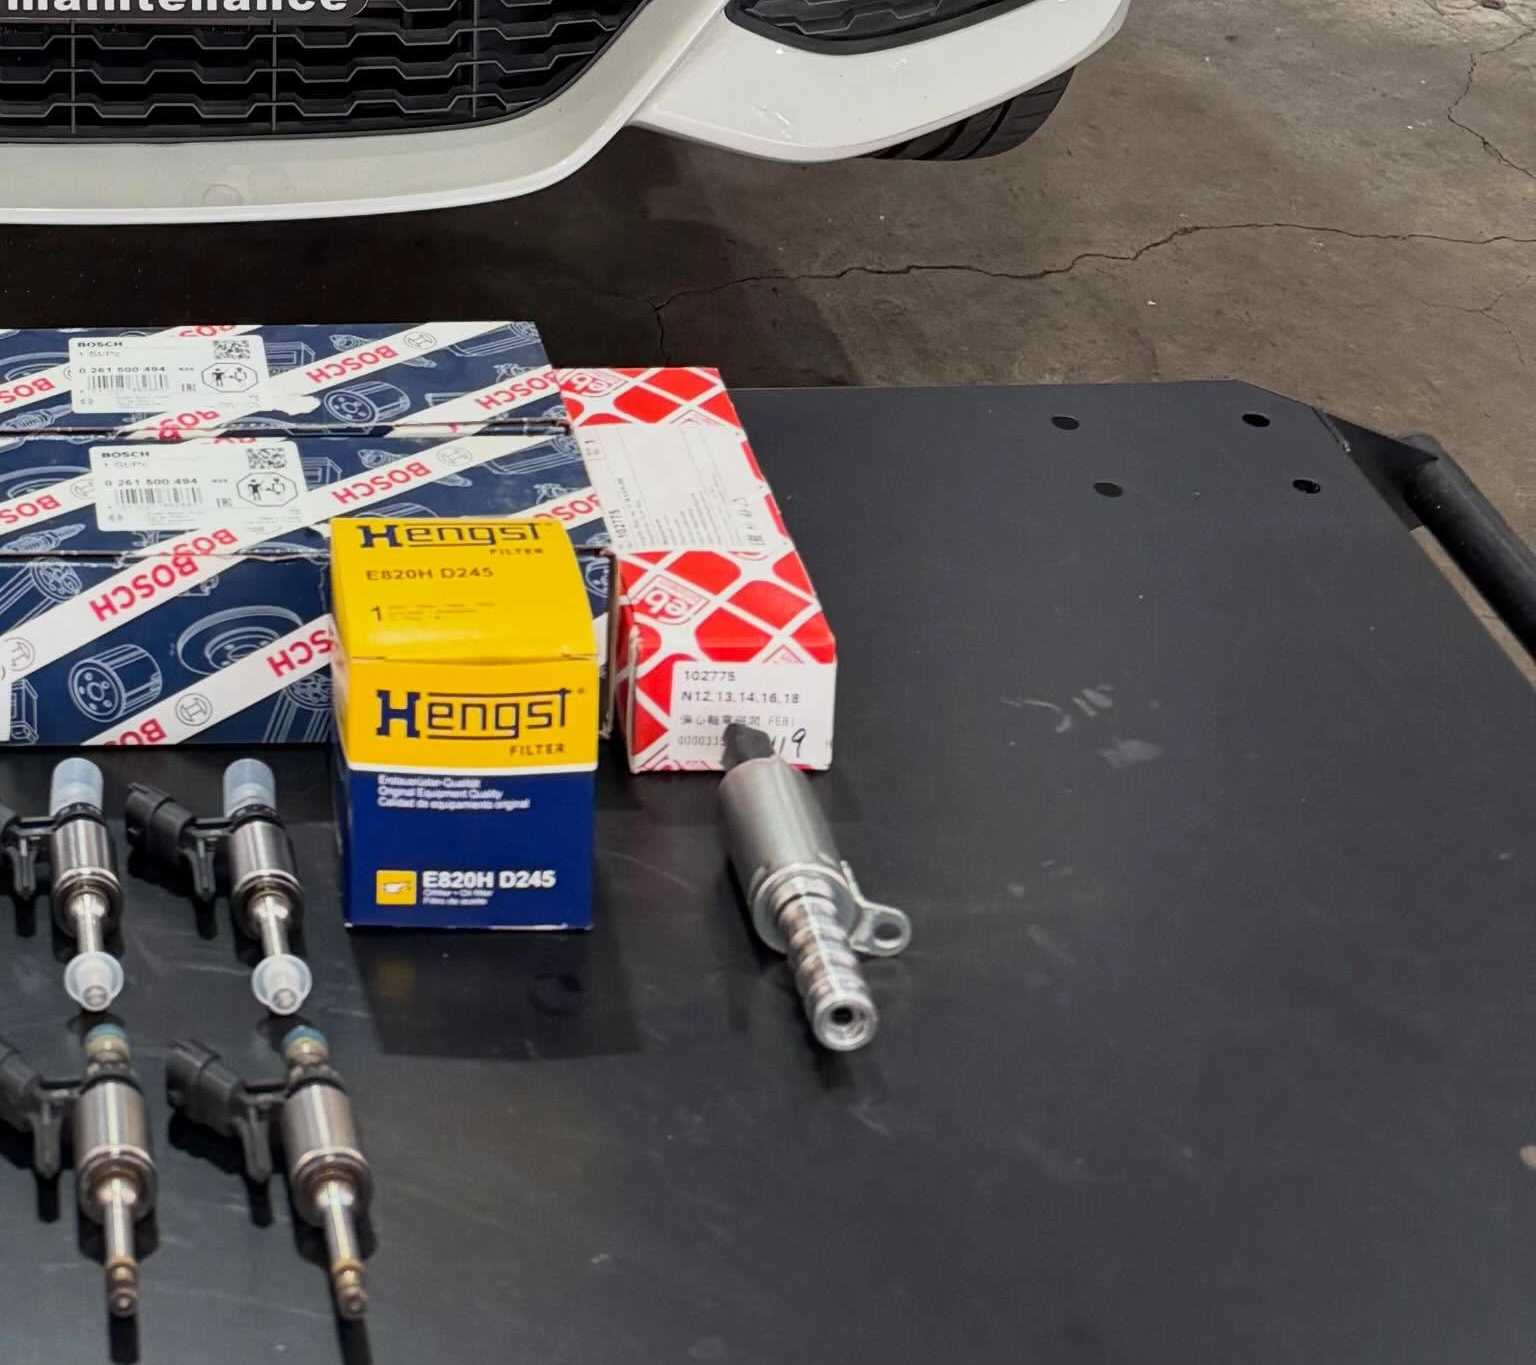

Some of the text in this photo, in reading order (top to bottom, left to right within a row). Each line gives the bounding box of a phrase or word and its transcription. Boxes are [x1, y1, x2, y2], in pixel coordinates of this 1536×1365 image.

[306, 345, 399, 384] BOSCH
[331, 461, 432, 505] BOSCH
[357, 522, 542, 549] Hengst
[365, 567, 494, 581] E820H D245
[88, 552, 200, 622] BOSCH
[371, 606, 382, 621] 1
[684, 670, 736, 682] 102775
[375, 687, 572, 740] Hengst
[509, 743, 565, 757] FILTER
[422, 869, 557, 889] E820H D245
